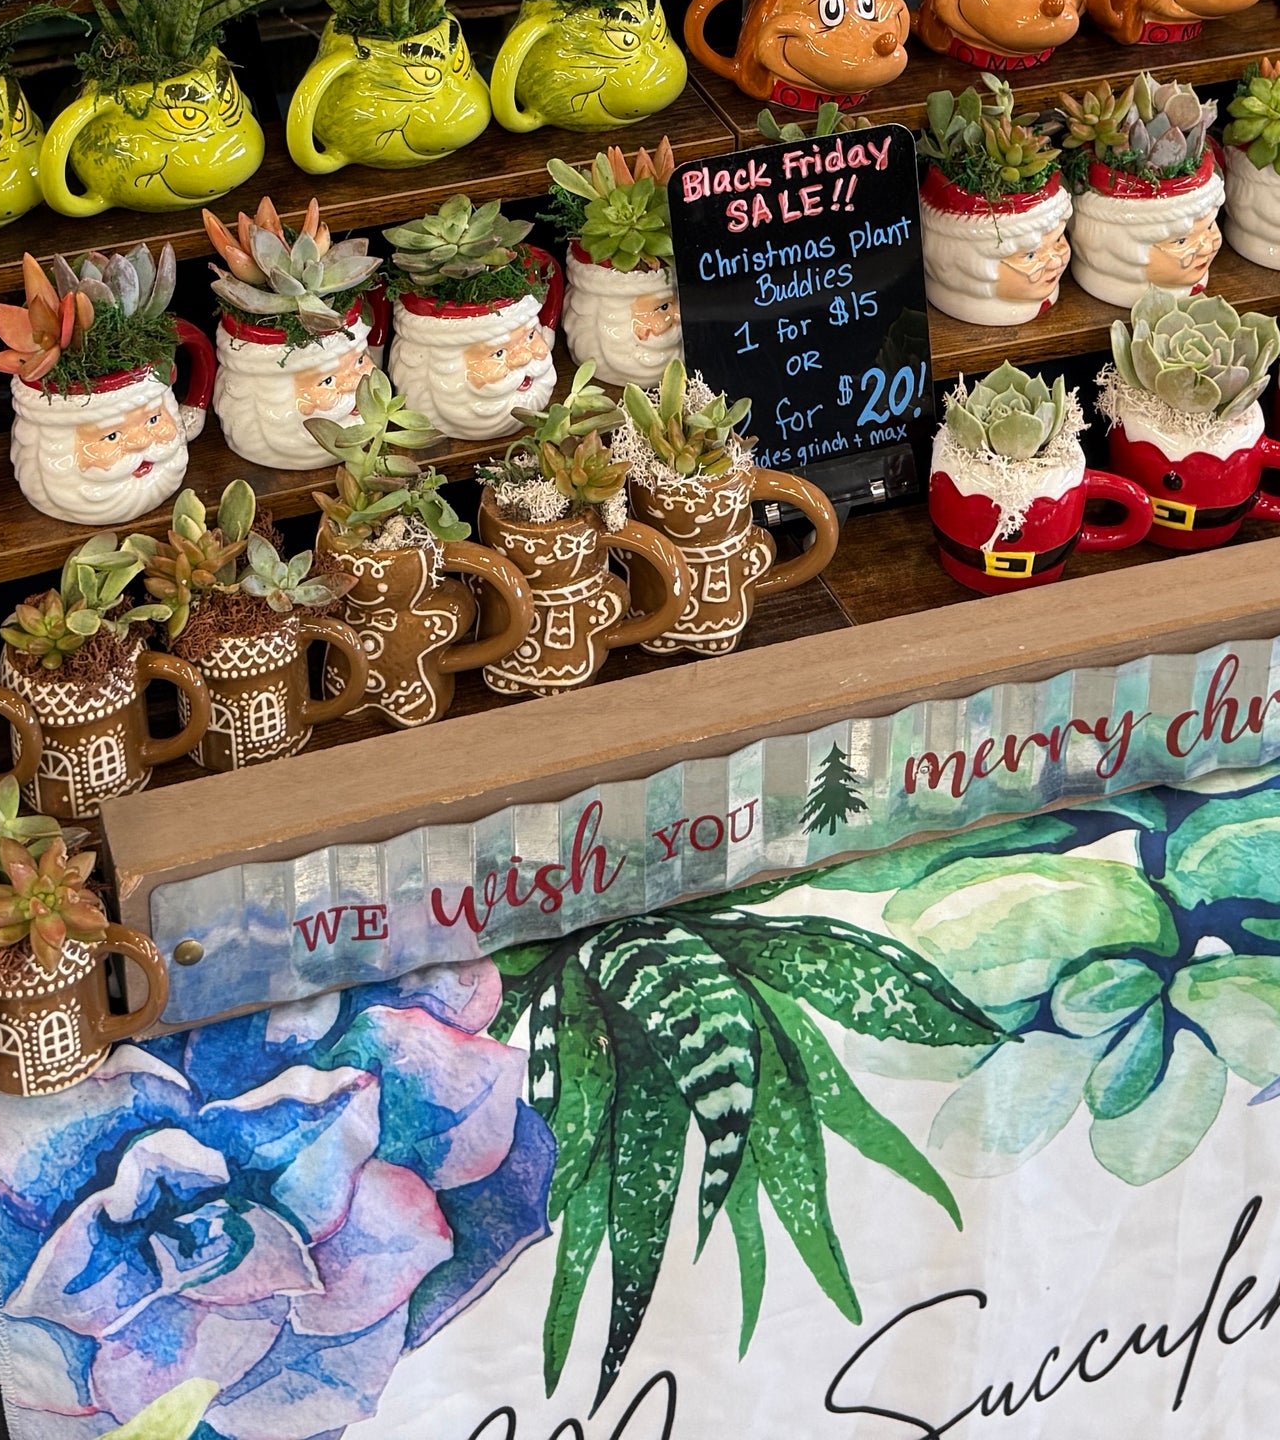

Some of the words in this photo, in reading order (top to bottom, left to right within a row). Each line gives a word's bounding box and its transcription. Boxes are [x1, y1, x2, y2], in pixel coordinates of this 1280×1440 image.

[681, 160, 772, 204] Black
[781, 136, 893, 181] Friday
[726, 174, 859, 233] SALE!!
[698, 235, 835, 282] Christmas
[753, 263, 853, 308] Buddies
[734, 320, 760, 355] 1
[776, 317, 812, 344] for
[828, 290, 879, 327] $15
[785, 349, 823, 376] OR
[776, 396, 824, 441] for
[836, 361, 928, 429] $20!
[796, 431, 849, 467] grinch
[869, 423, 908, 446] max
[293, 903, 389, 952] WE
[430, 800, 626, 934] wish
[651, 798, 759, 862] YOU
[904, 707, 1153, 799] merry
